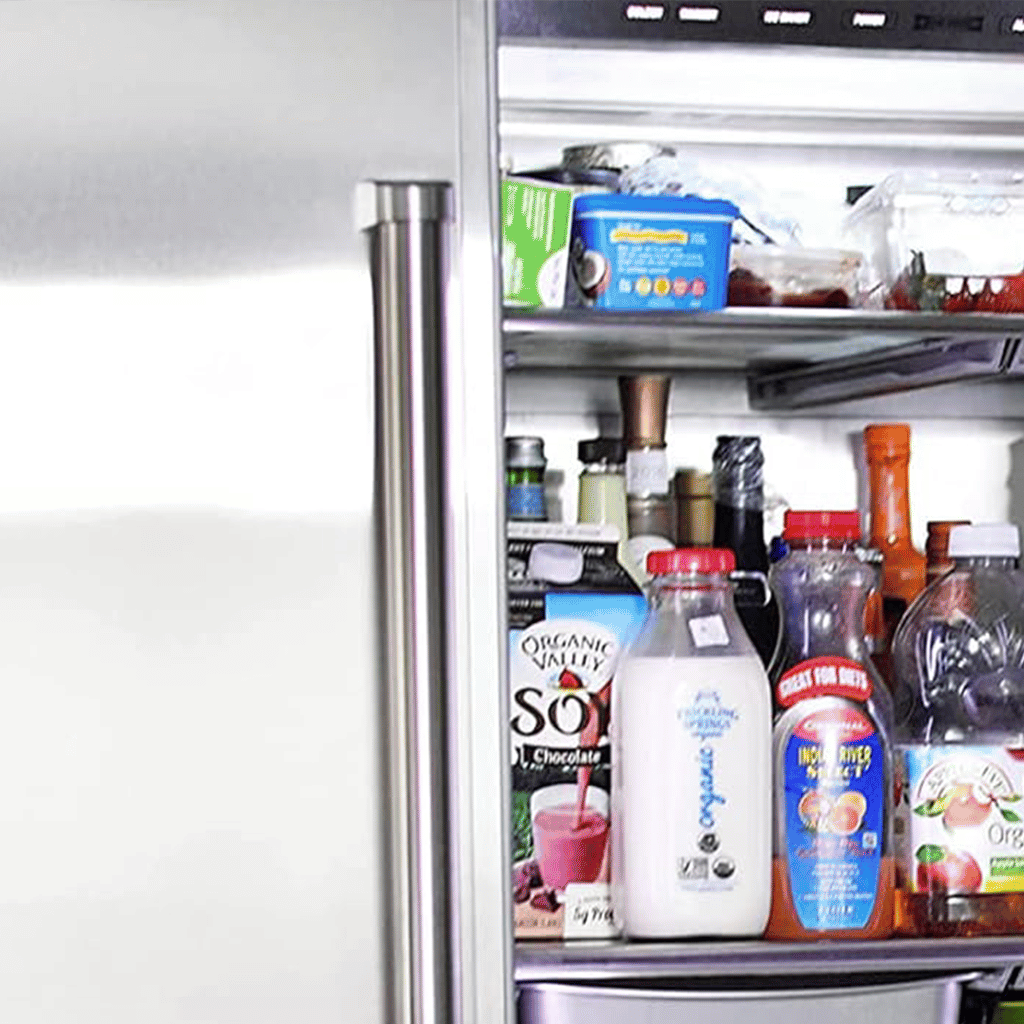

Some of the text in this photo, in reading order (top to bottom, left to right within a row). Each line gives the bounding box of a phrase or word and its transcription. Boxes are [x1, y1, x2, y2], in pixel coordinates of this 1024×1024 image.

[521, 633, 614, 656] ORGANIC
[532, 652, 606, 672] VALLEY
[533, 747, 602, 764] Chocolate
[699, 748, 727, 829] organic
